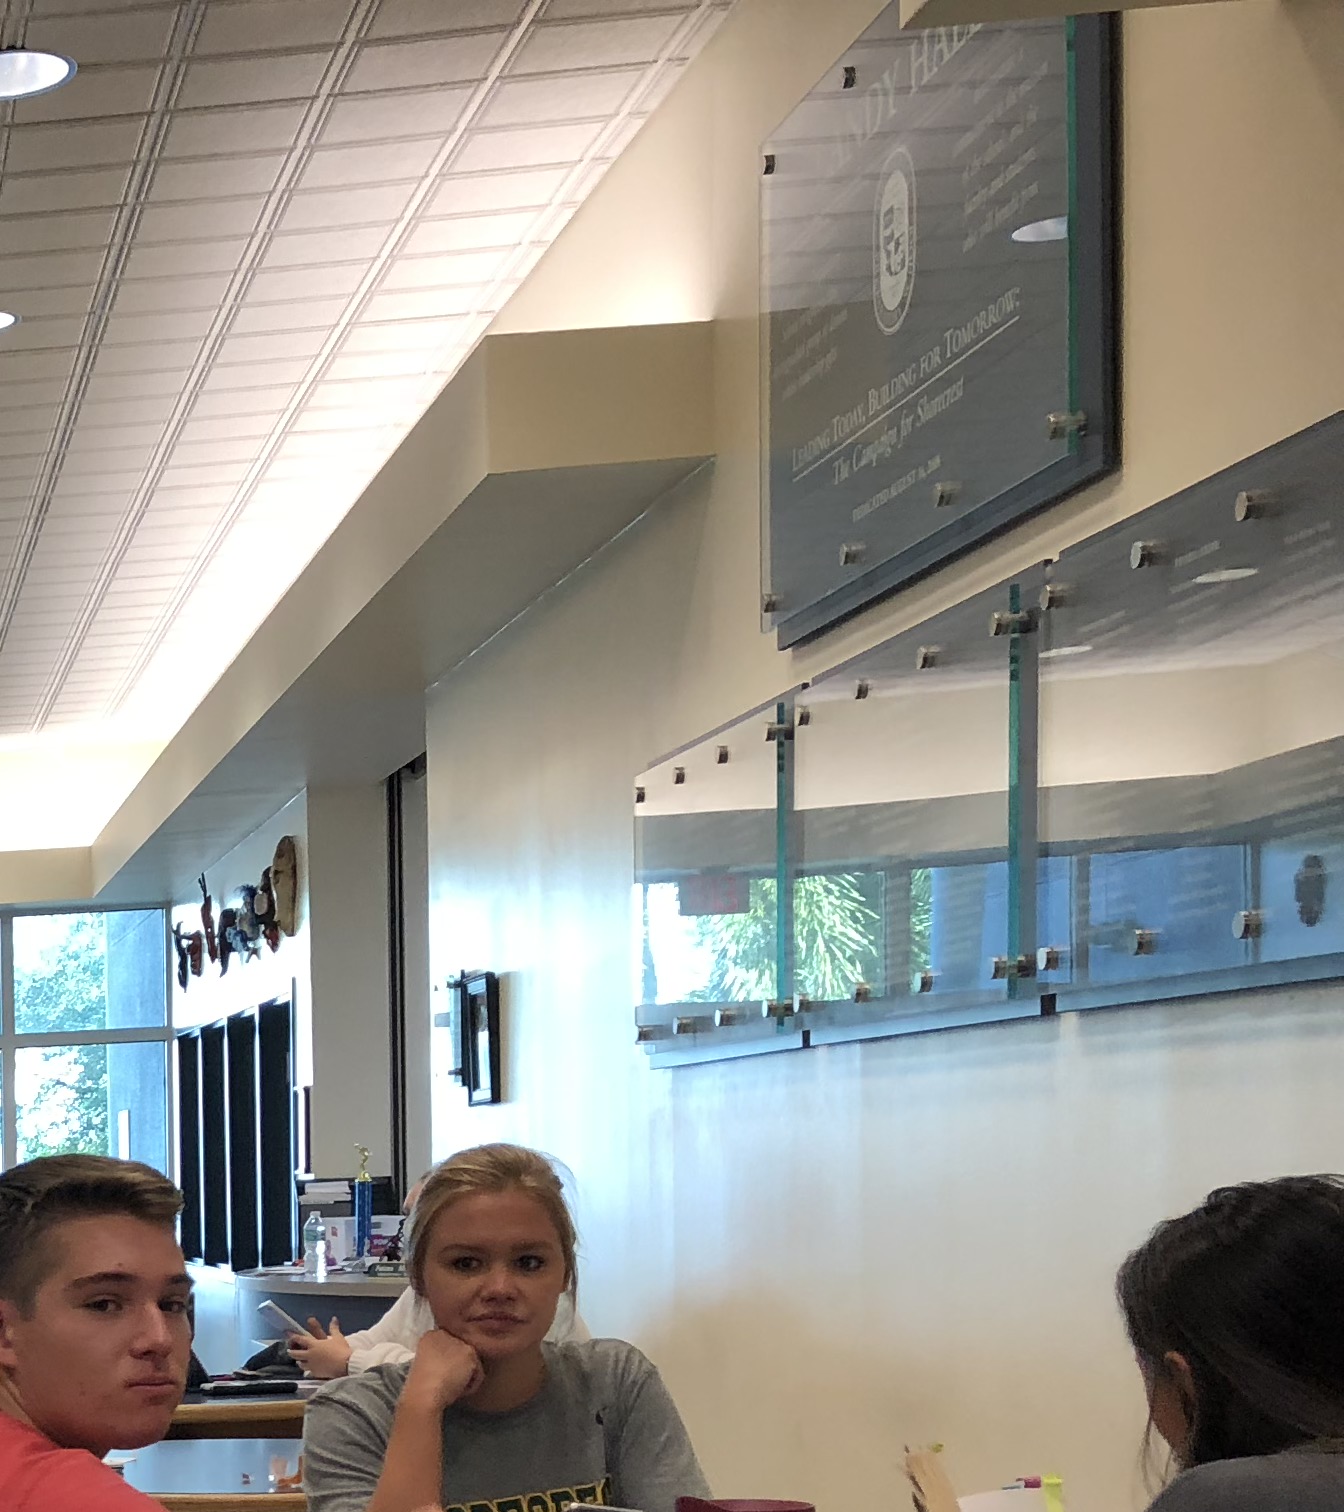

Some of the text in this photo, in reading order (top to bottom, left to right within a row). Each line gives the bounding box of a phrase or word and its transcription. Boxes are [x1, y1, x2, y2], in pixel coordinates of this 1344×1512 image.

[792, 428, 830, 472] LEADING
[868, 362, 917, 415] BUILDING
[920, 346, 942, 377] FOR
[833, 459, 850, 485] The
[898, 410, 913, 448] for
